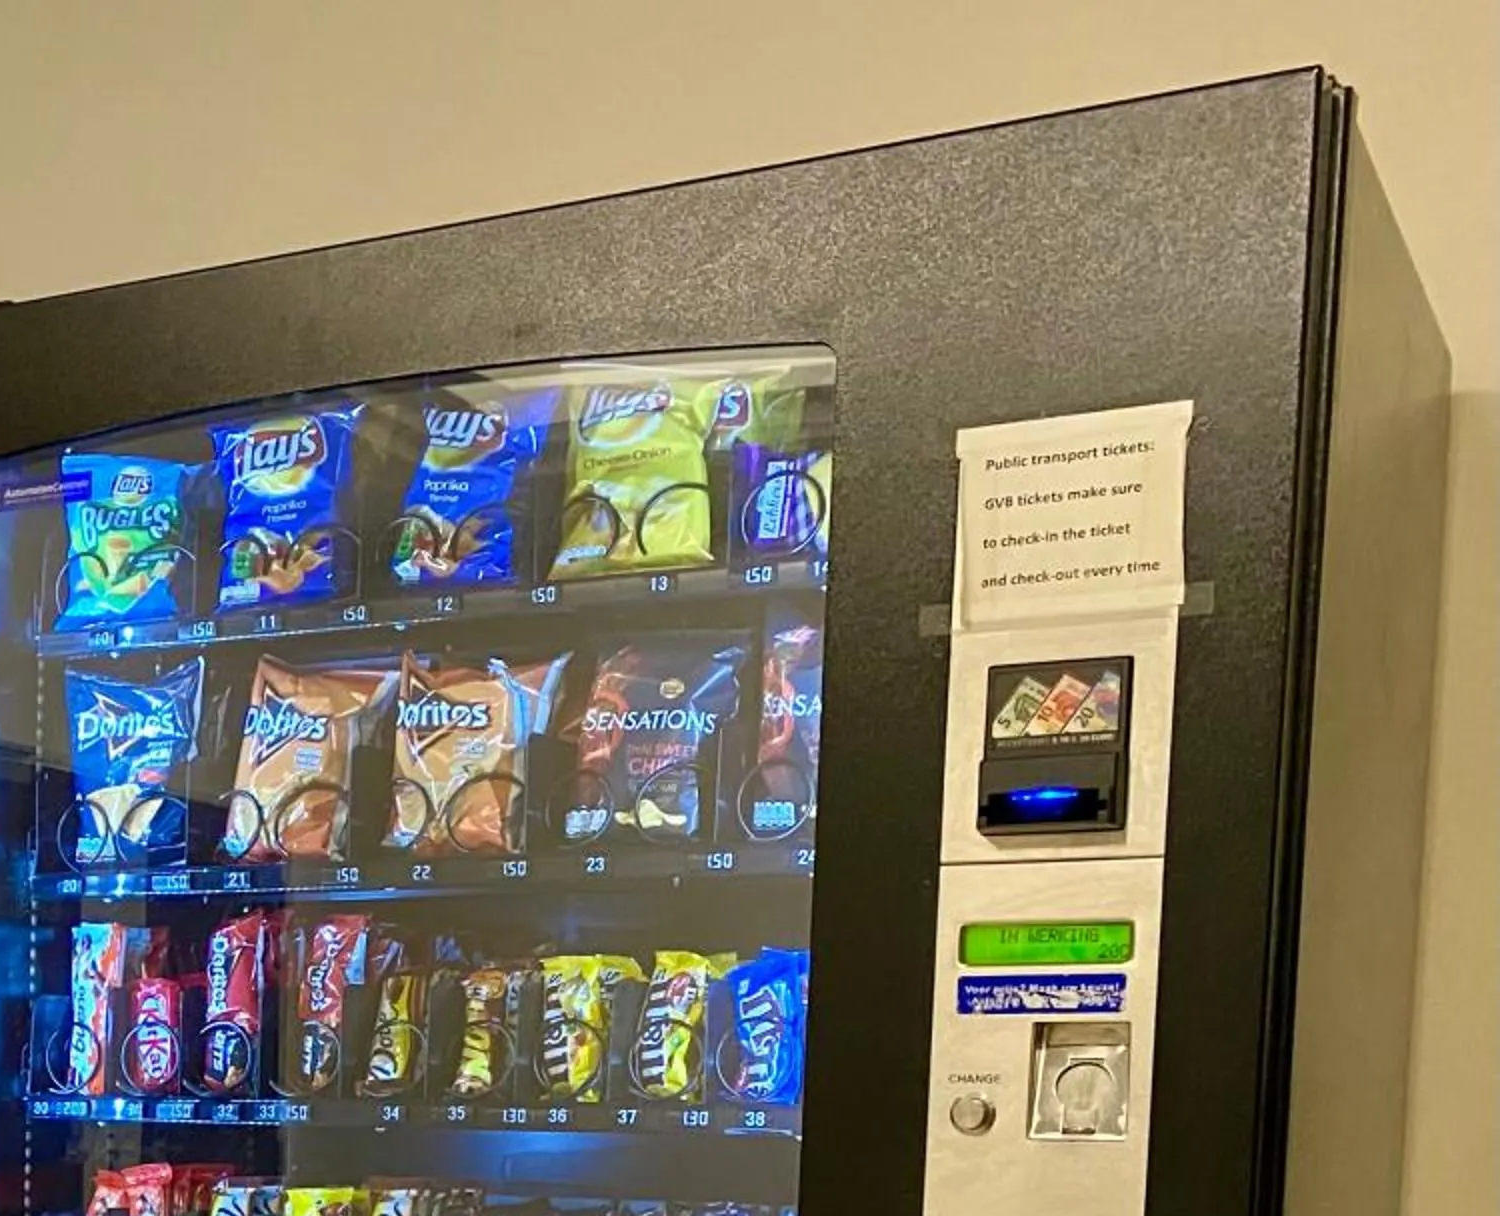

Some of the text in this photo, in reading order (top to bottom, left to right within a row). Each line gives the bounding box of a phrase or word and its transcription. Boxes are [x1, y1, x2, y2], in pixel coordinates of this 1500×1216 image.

[985, 440, 1156, 472] Public transport tickets:
[984, 482, 1143, 511] GVB tickets make sure
[982, 523, 1131, 550] to check-in the ticket
[980, 559, 1161, 588] and check-out every time
[650, 576, 669, 592] 13
[436, 596, 453, 611] 12
[763, 693, 822, 718] SENSA
[582, 708, 718, 735] SENSATIONS
[997, 705, 1096, 729] 5 10 20
[412, 864, 432, 880] 22
[586, 857, 605, 872] 23
[227, 872, 245, 886] 21
[947, 1073, 1002, 1084] CHANGE
[216, 1105, 234, 1118] 32
[258, 1104, 275, 1118] 33
[382, 1106, 400, 1121] 34
[446, 1105, 466, 1121] 35
[547, 1108, 568, 1124] 36
[617, 1109, 637, 1125] 37
[744, 1111, 766, 1127] 38
